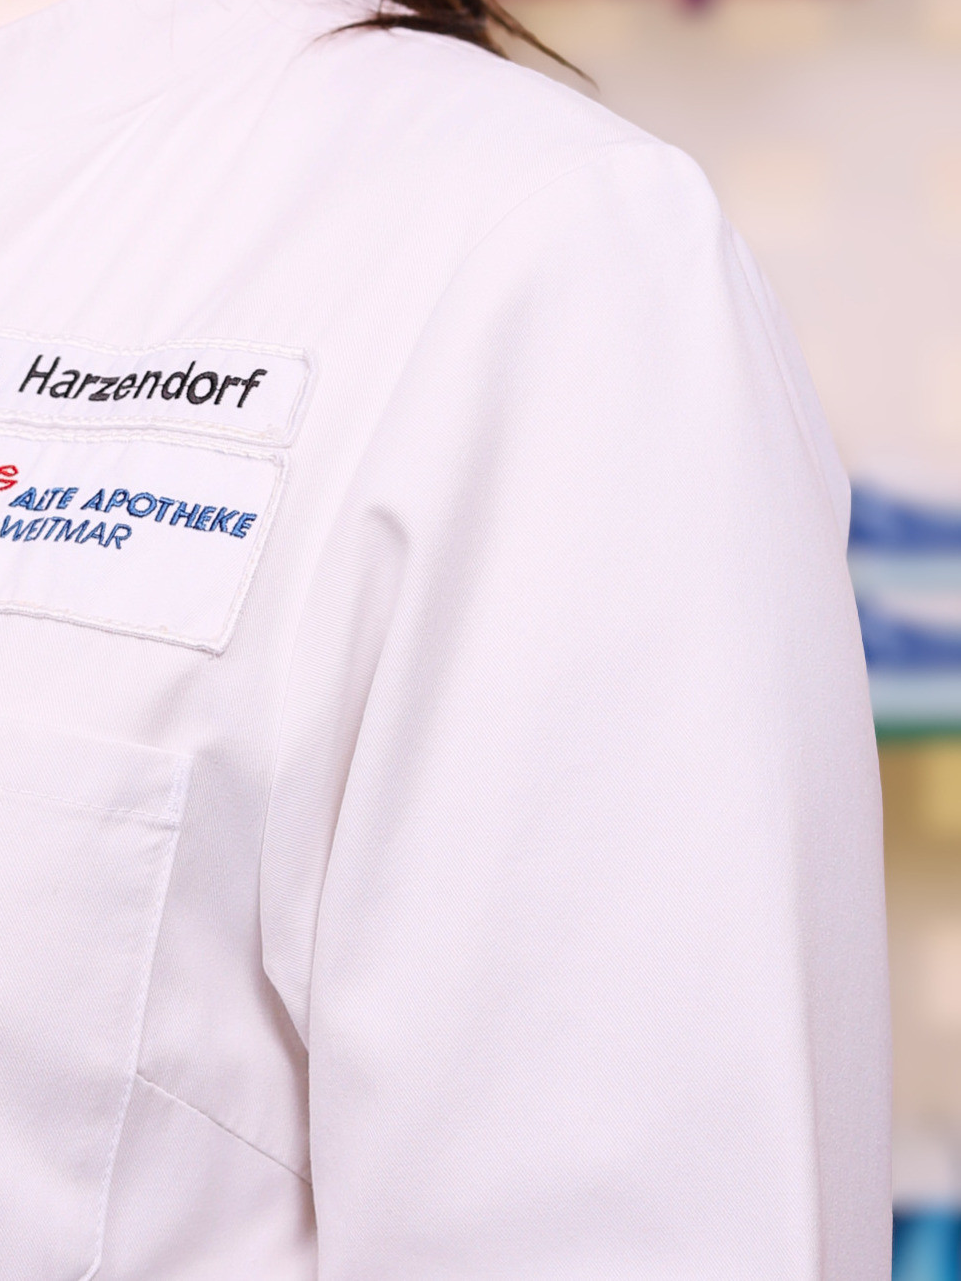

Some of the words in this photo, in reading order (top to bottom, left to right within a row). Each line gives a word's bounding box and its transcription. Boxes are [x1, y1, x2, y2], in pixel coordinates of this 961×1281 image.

[18, 354, 268, 409] Harzendorf
[0, 515, 132, 550] WEITMAR
[8, 486, 79, 511] ALTE
[80, 488, 258, 539] APOTHEKE
